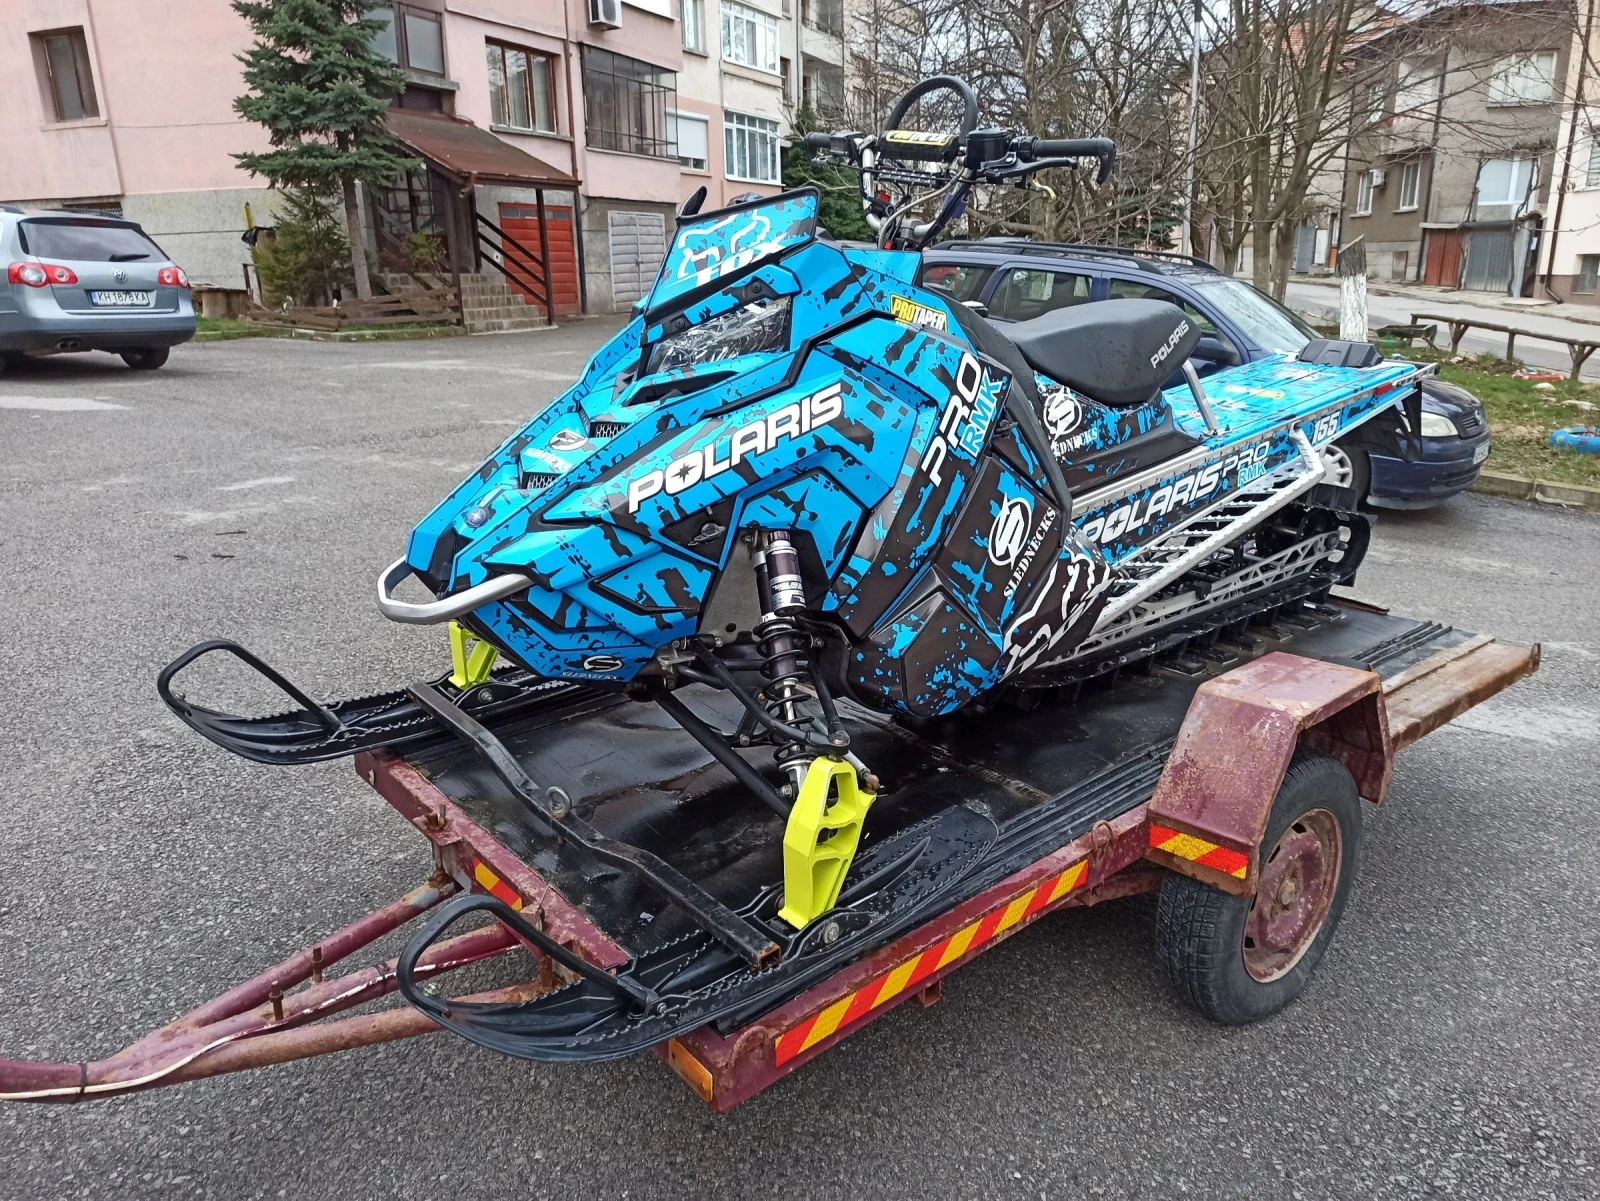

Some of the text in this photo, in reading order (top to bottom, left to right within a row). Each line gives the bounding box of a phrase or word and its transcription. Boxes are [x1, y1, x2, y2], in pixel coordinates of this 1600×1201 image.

[892, 299, 945, 331] PROTAPER
[1150, 320, 1189, 369] POLARIS
[628, 382, 842, 514] POLARIS
[921, 352, 982, 488] PRO
[959, 367, 1003, 457] RMK
[1312, 411, 1340, 445] 155
[1081, 441, 1270, 544] POLARIS PRO
[1237, 457, 1268, 488] RMK
[1004, 506, 1056, 600] SLEDNECKS
